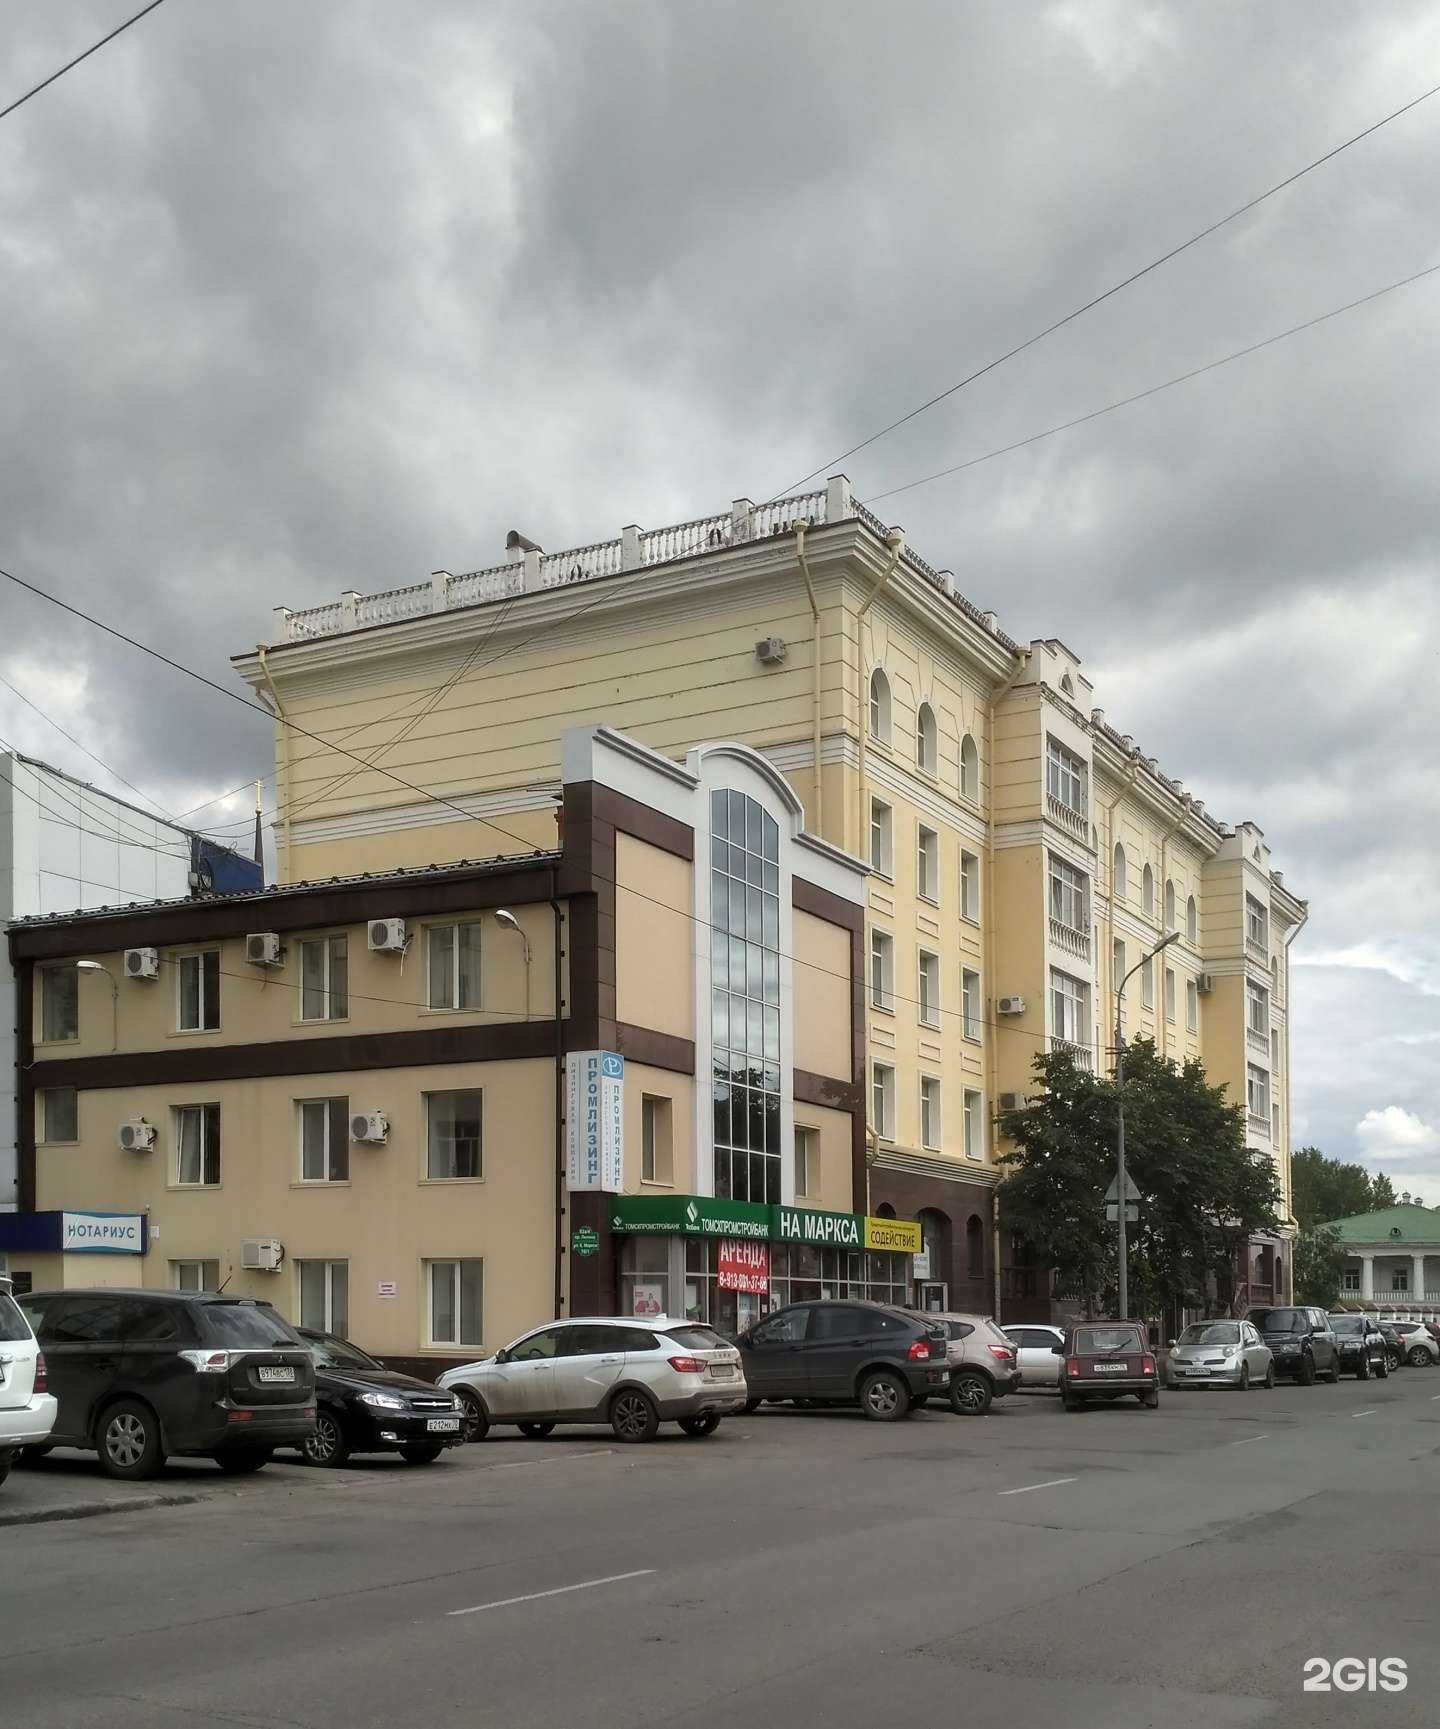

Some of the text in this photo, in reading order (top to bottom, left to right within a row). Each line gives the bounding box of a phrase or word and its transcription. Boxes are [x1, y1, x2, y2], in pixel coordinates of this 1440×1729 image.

[587, 1058, 598, 1184] ПРОМЛИЗИНГ
[613, 1085, 621, 1186] ПРОМЛИЗИНГ
[68, 1224, 135, 1239] НОТАРИУС
[701, 1218, 769, 1237] ТОМСКПРОМСТРОЙБАНК
[780, 1212, 859, 1244] НА МАРКСА
[870, 1230, 916, 1248] СОДЕЙСТВИЕ
[720, 1239, 766, 1269] АРЕНДА
